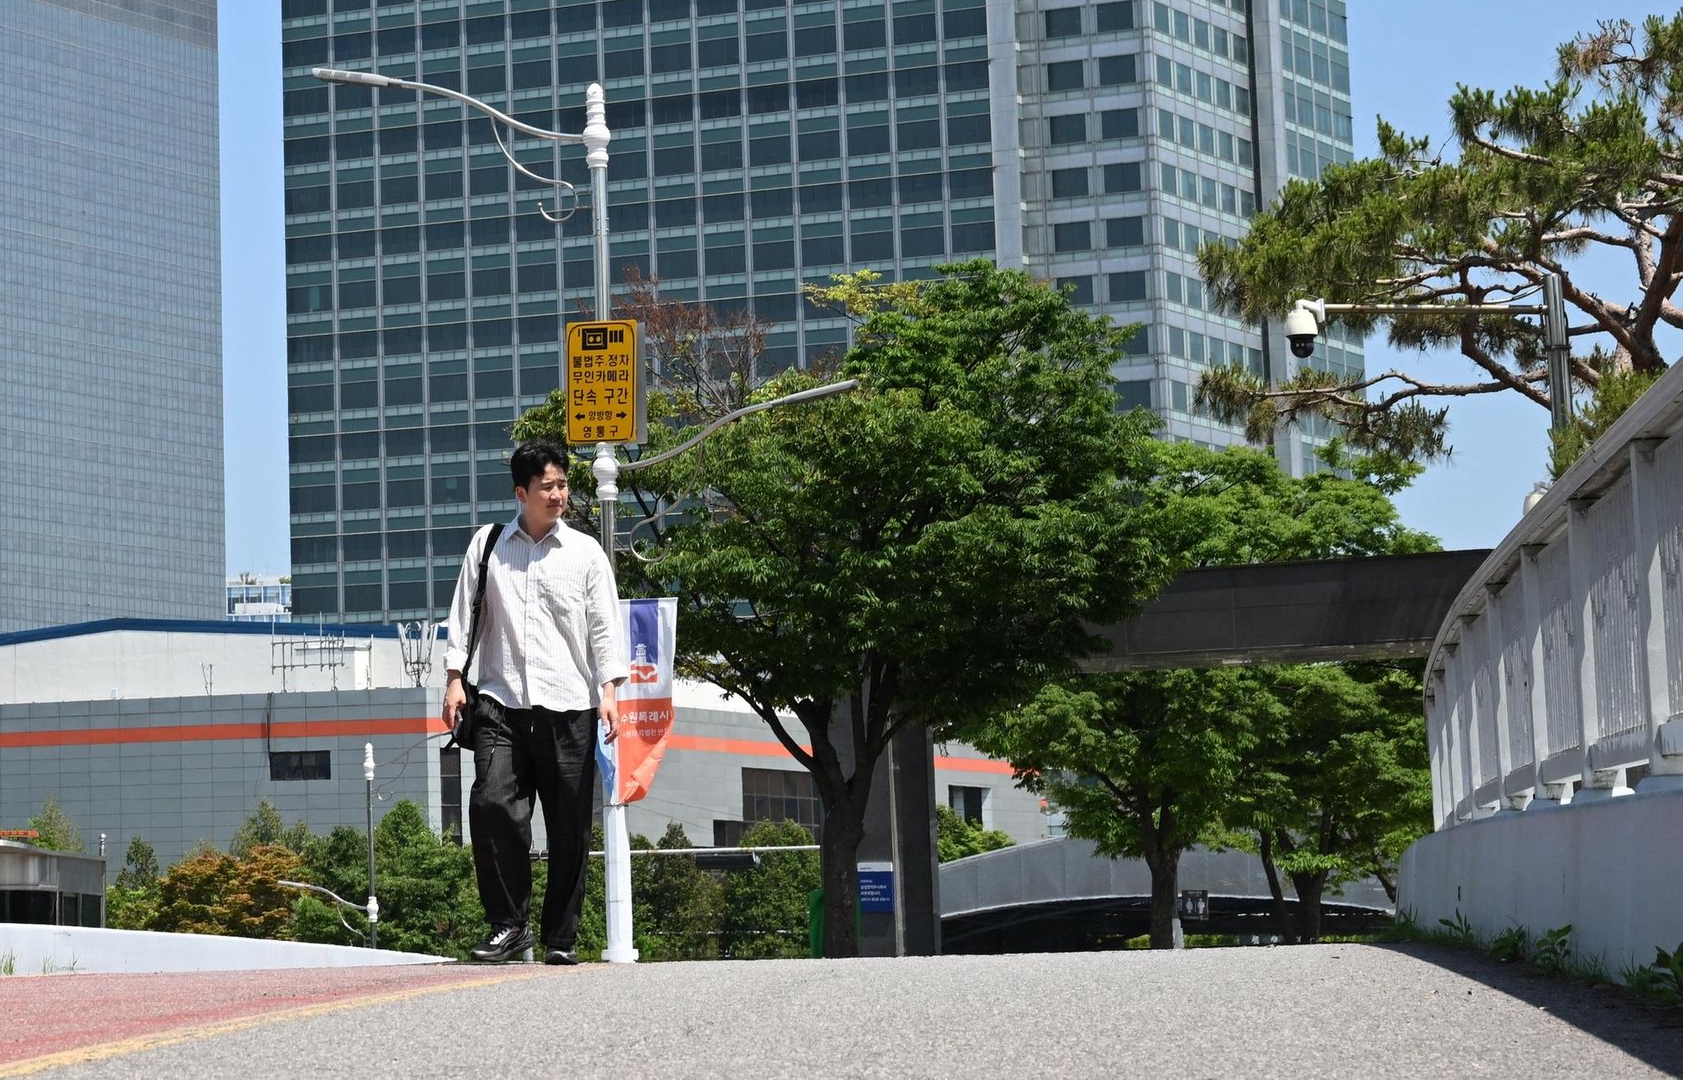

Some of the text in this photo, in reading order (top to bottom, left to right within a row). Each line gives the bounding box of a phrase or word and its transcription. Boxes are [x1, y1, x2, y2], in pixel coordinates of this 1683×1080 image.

[573, 370, 629, 383] 무인카메라
[574, 388, 628, 405] 단속 구간
[583, 425, 619, 439] 영통구
[621, 711, 668, 724] 수원특례시
